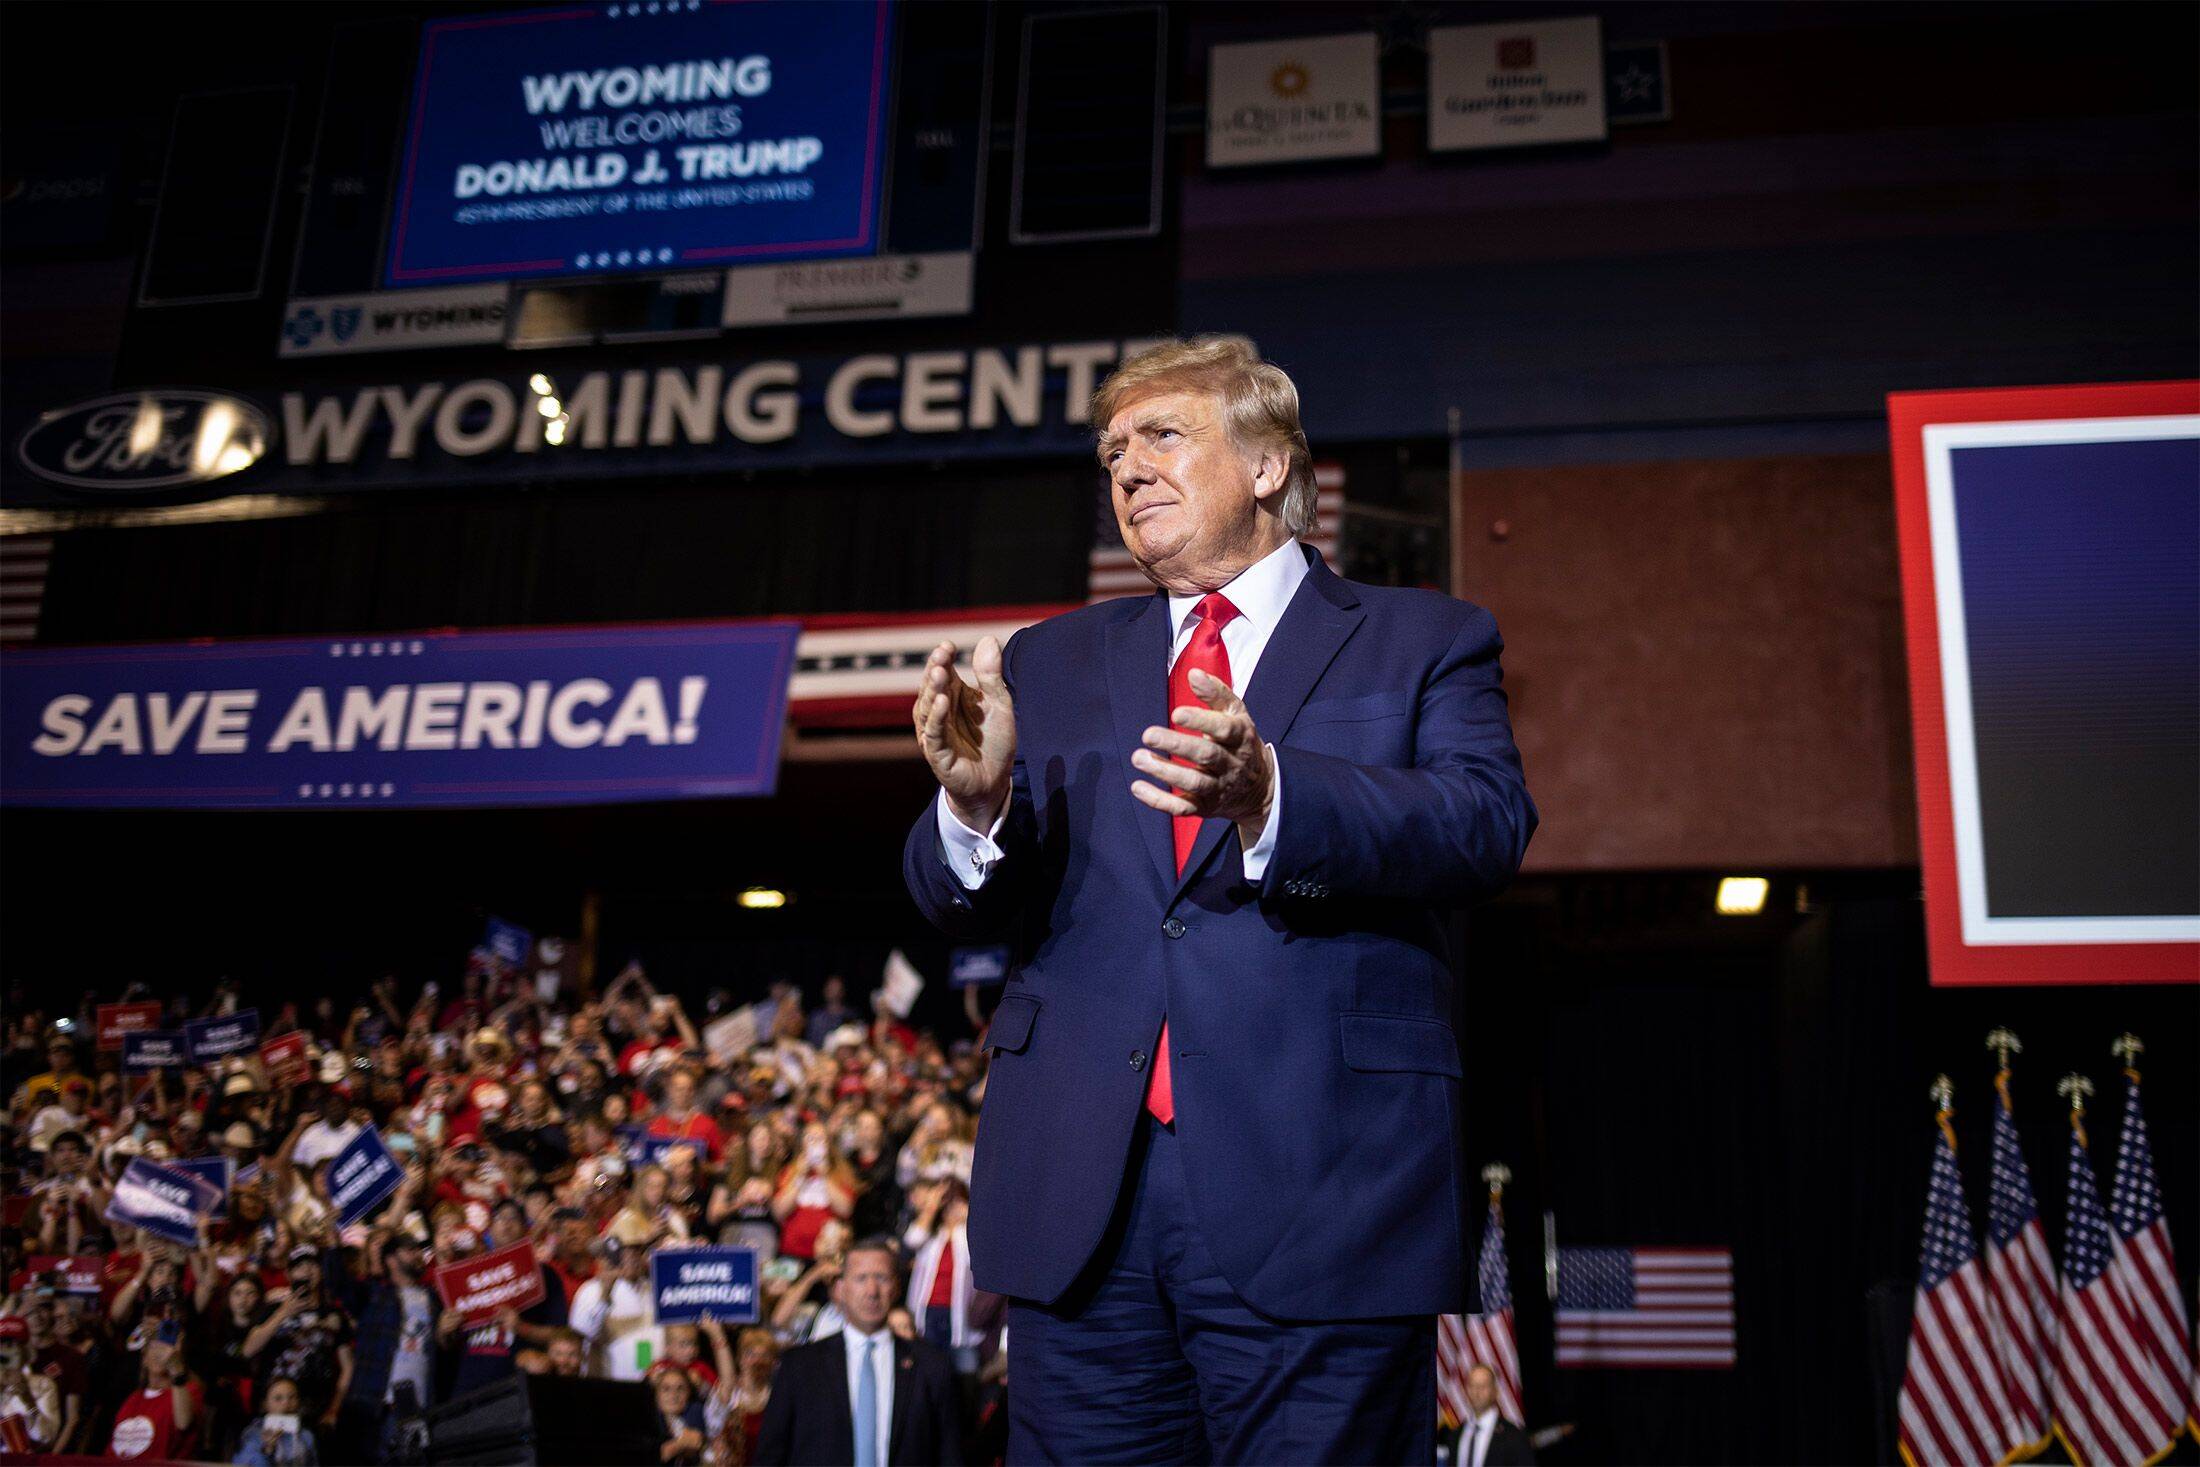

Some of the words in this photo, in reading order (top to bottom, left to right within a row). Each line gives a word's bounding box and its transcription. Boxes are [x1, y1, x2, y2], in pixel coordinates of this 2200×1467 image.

[522, 55, 771, 114] WYOMING
[540, 104, 742, 150] WELCOMES
[455, 152, 629, 198] DONALD
[632, 149, 669, 184] J.
[675, 136, 823, 180] TRUMP
[281, 358, 802, 467] WYOMING
[31, 689, 259, 757] SAVE
[266, 674, 707, 752] AMERICA!
[660, 1283, 752, 1308] AMERICA!
[679, 1262, 733, 1283] SAVE
